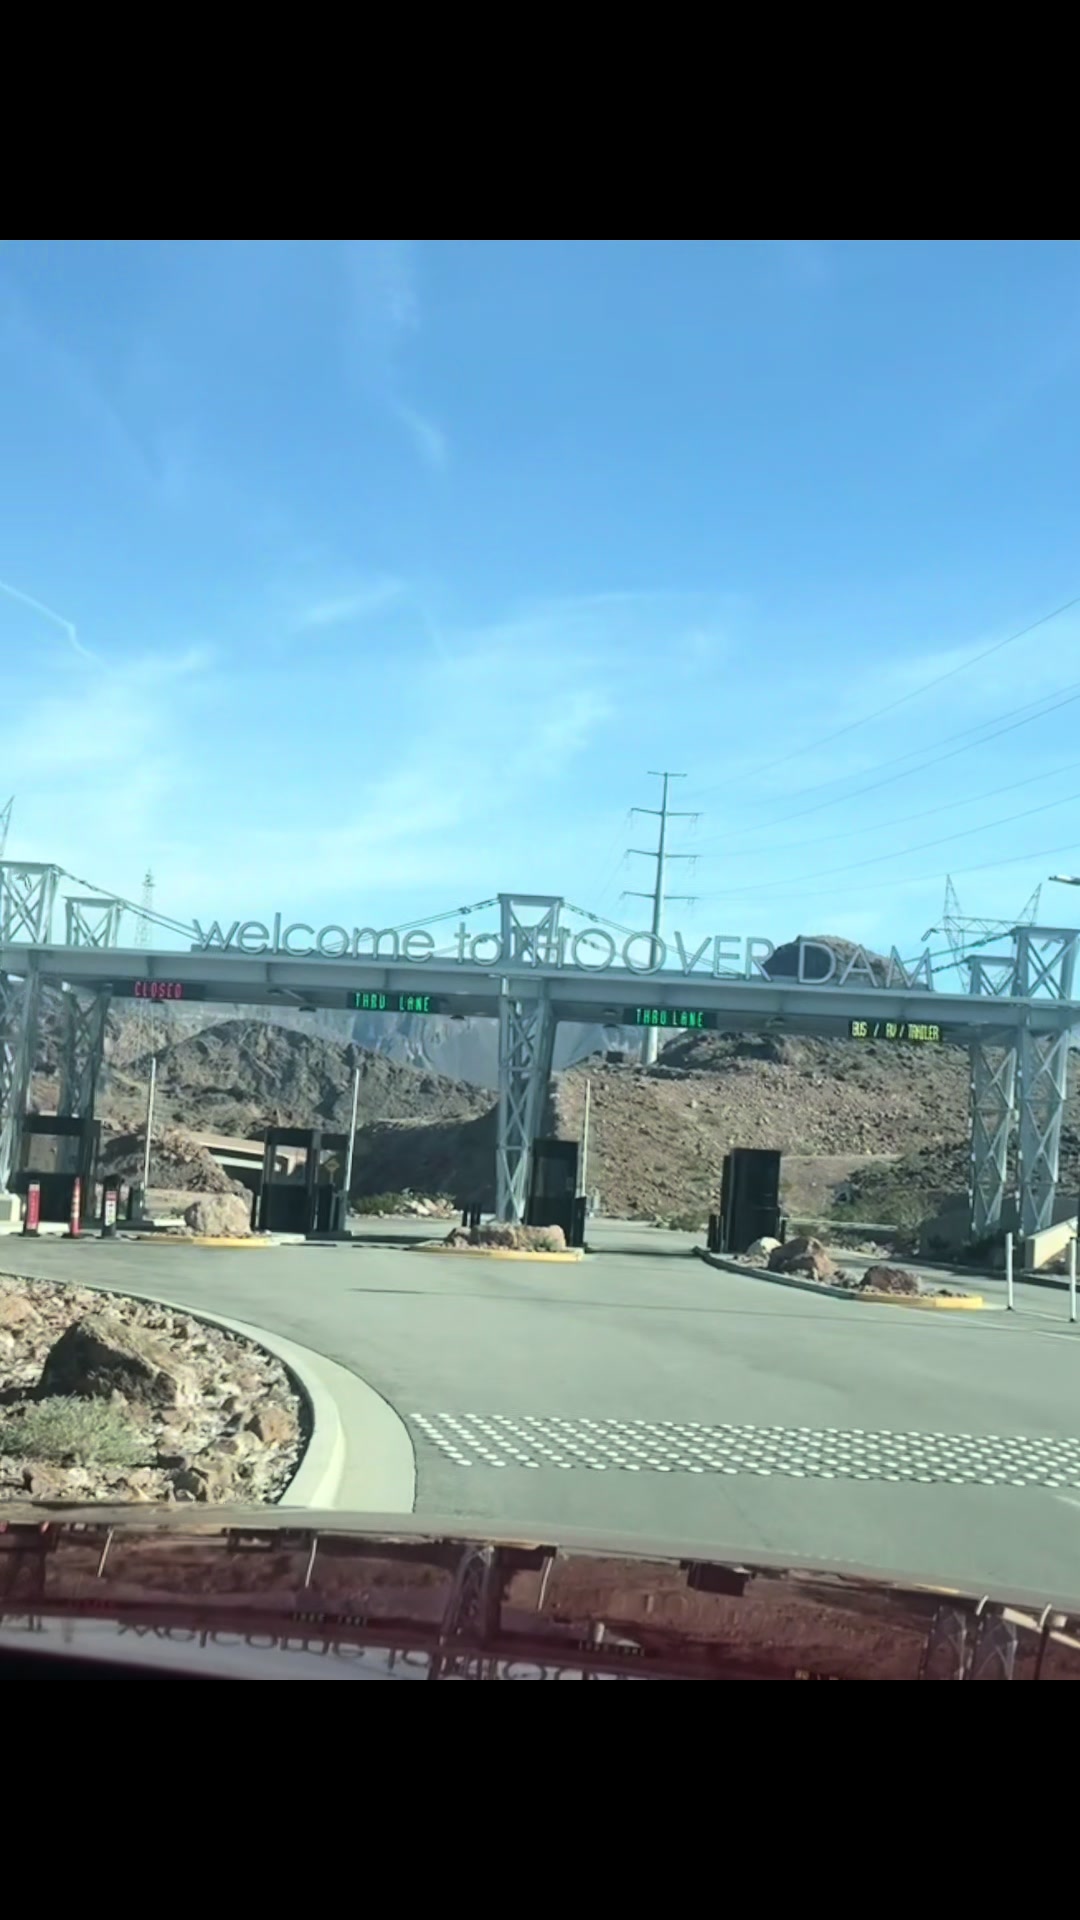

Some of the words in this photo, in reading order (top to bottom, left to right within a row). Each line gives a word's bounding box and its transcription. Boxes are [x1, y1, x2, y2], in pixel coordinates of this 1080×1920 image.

[193, 912, 435, 964] welcome
[454, 922, 502, 967] to
[531, 926, 773, 983] HOOVER
[797, 941, 934, 992] DAM
[134, 981, 183, 999] CLOSED
[355, 992, 386, 1010] THRU
[399, 995, 430, 1012] LANE
[636, 1008, 667, 1026] THRU
[672, 1010, 704, 1028] LANE
[851, 1020, 868, 1037] BUS
